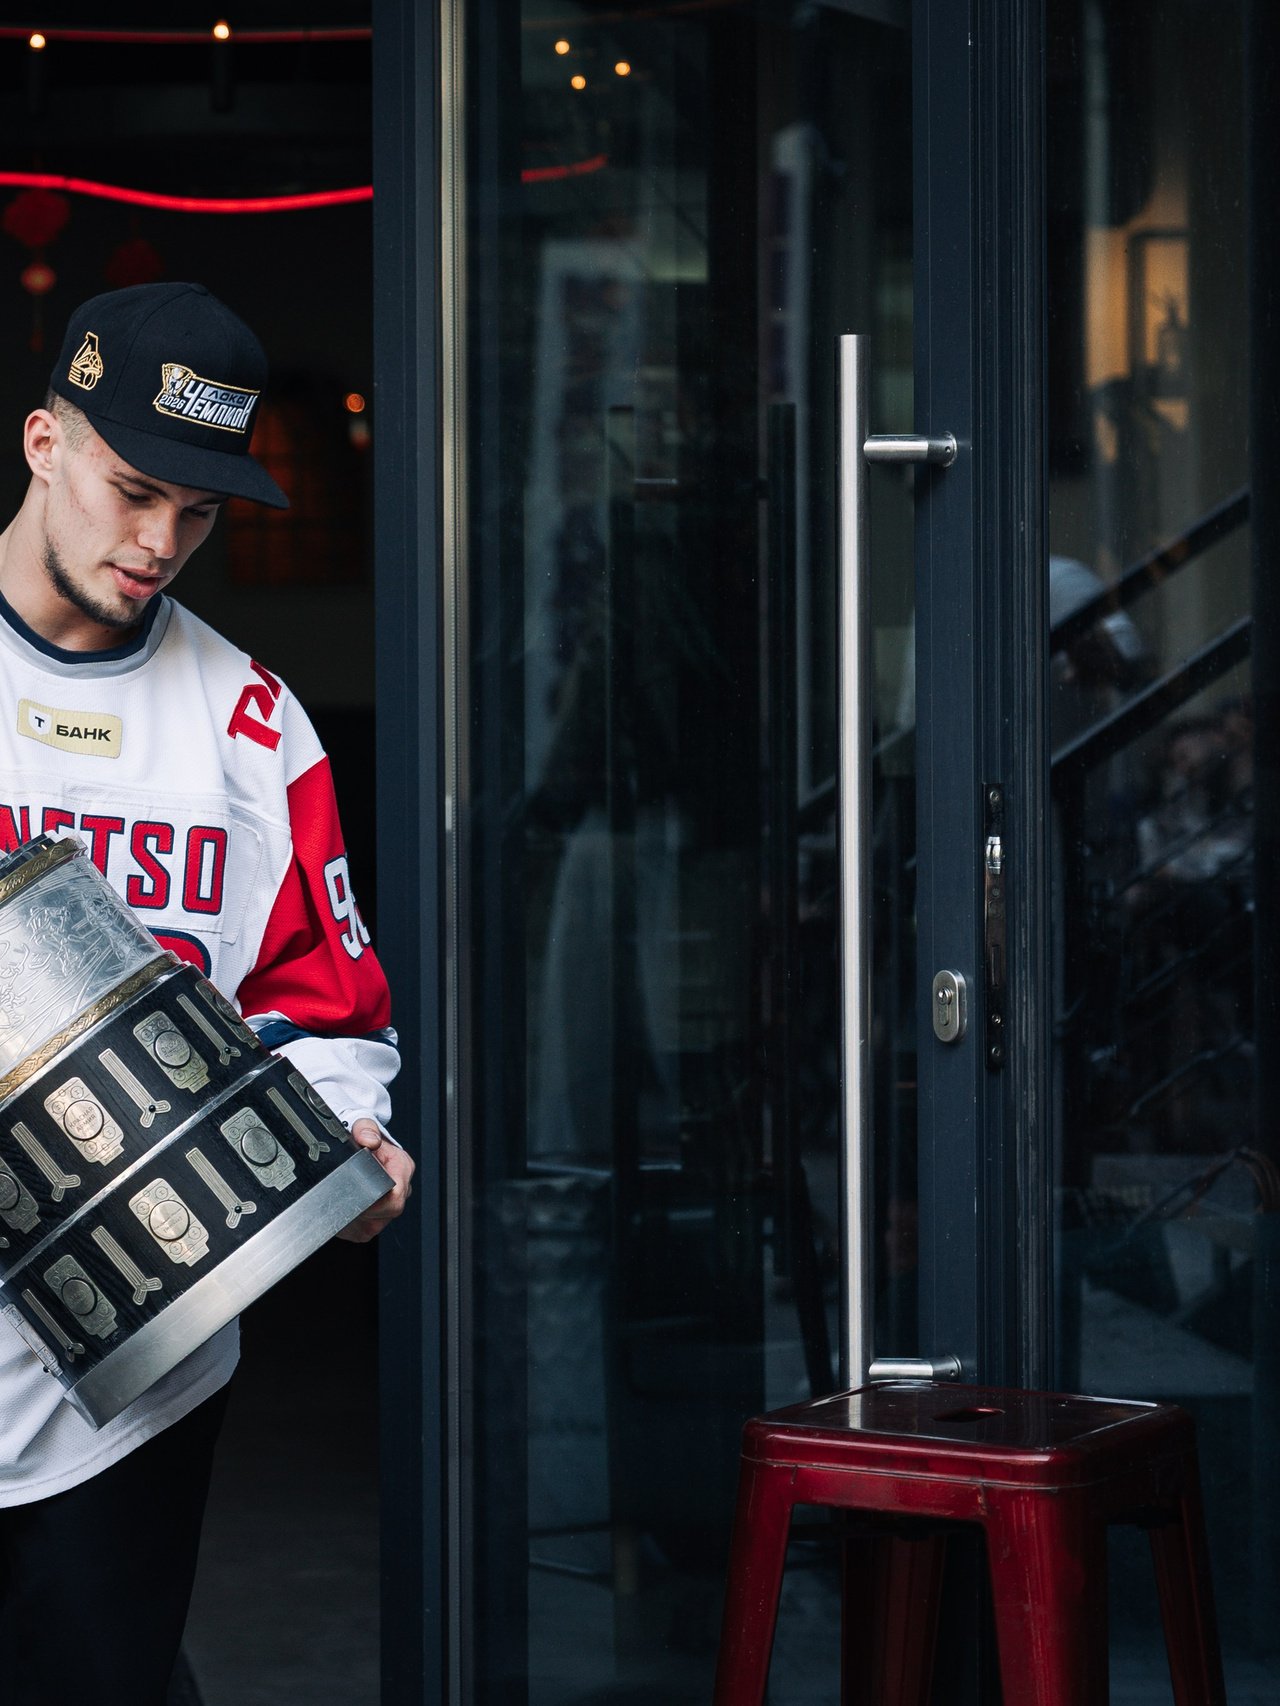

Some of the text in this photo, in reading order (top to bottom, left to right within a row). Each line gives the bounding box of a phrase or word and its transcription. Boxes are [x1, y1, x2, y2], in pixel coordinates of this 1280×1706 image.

[160, 395, 186, 410] 2026
[56, 724, 111, 742] БАНК
[68, 1106, 96, 1129] КРАСНАЯ
[76, 1114, 97, 1132] АРМИЯ
